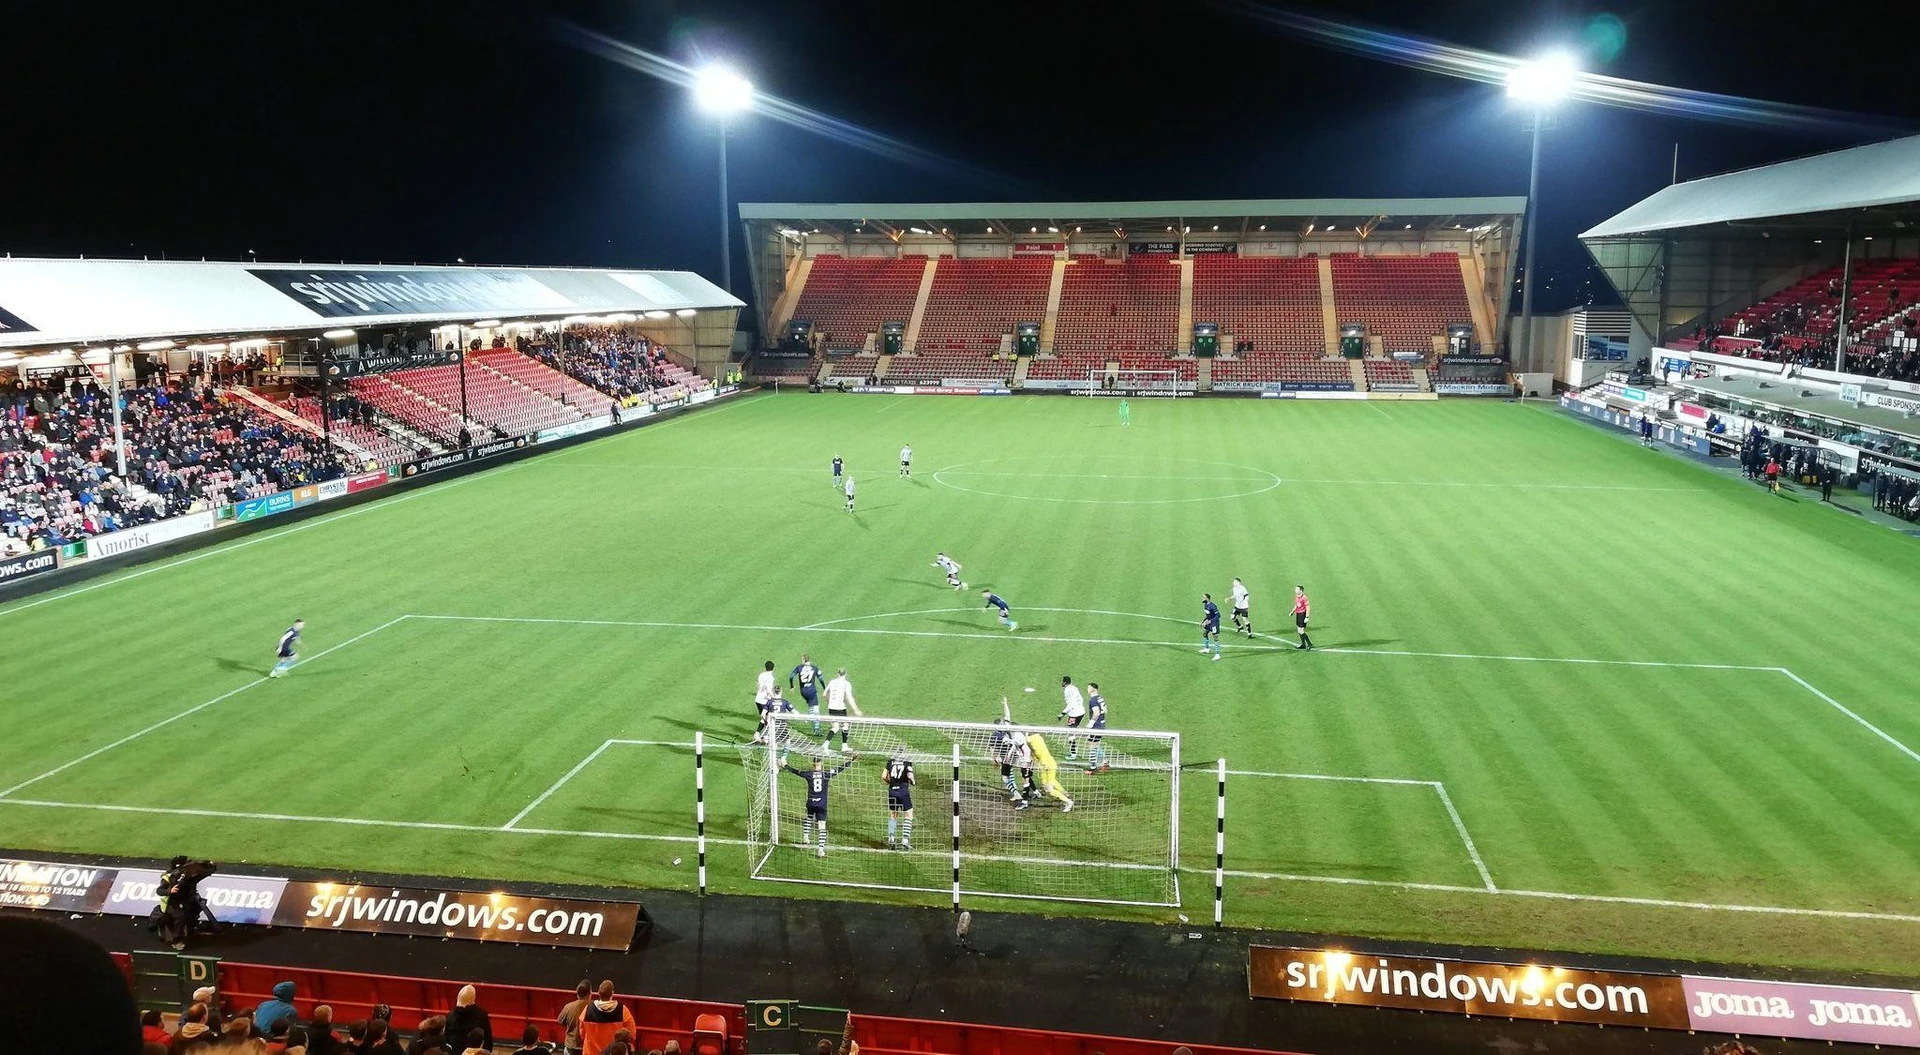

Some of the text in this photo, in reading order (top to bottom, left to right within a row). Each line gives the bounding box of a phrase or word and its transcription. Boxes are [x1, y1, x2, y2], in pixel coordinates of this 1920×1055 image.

[358, 361, 365, 373] A
[1878, 396, 1892, 407] CLUB
[421, 452, 464, 471] srjwindows.com
[94, 532, 150, 558] Amorist
[890, 764, 905, 779] 47
[813, 778, 822, 792] 8
[0, 864, 97, 888] NATION
[52, 886, 63, 895] 12
[306, 885, 605, 937] srjwindows.com
[190, 960, 207, 980] D
[1286, 955, 1650, 1014] srjwindows.com
[763, 1005, 782, 1027] C
